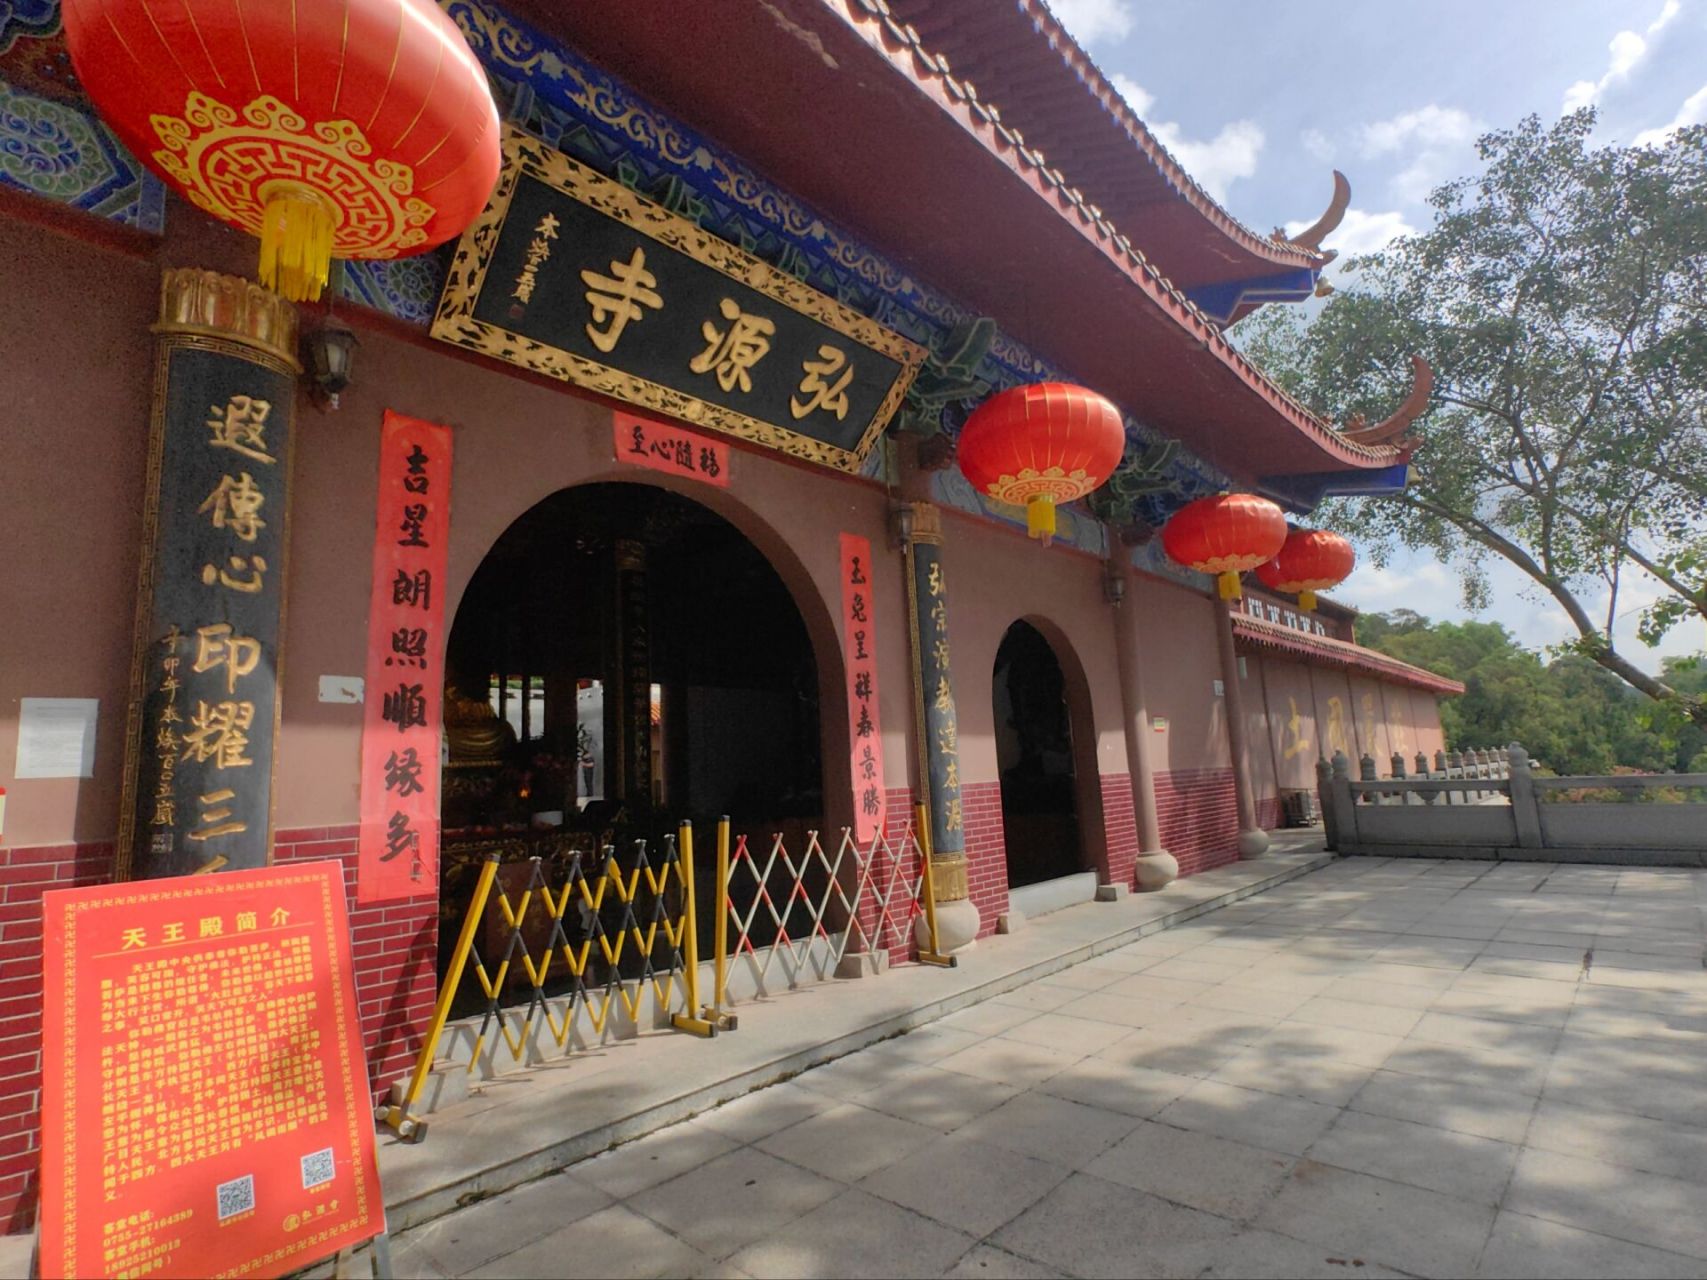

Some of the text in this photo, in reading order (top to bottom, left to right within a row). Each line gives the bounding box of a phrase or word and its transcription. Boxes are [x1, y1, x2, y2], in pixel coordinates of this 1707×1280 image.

[581, 245, 854, 422] 弘源寺
[182, 395, 277, 874] 遐傳心印耀三
[380, 443, 431, 863] 吉星朗照順緣多
[121, 907, 291, 950] 天王殿简介
